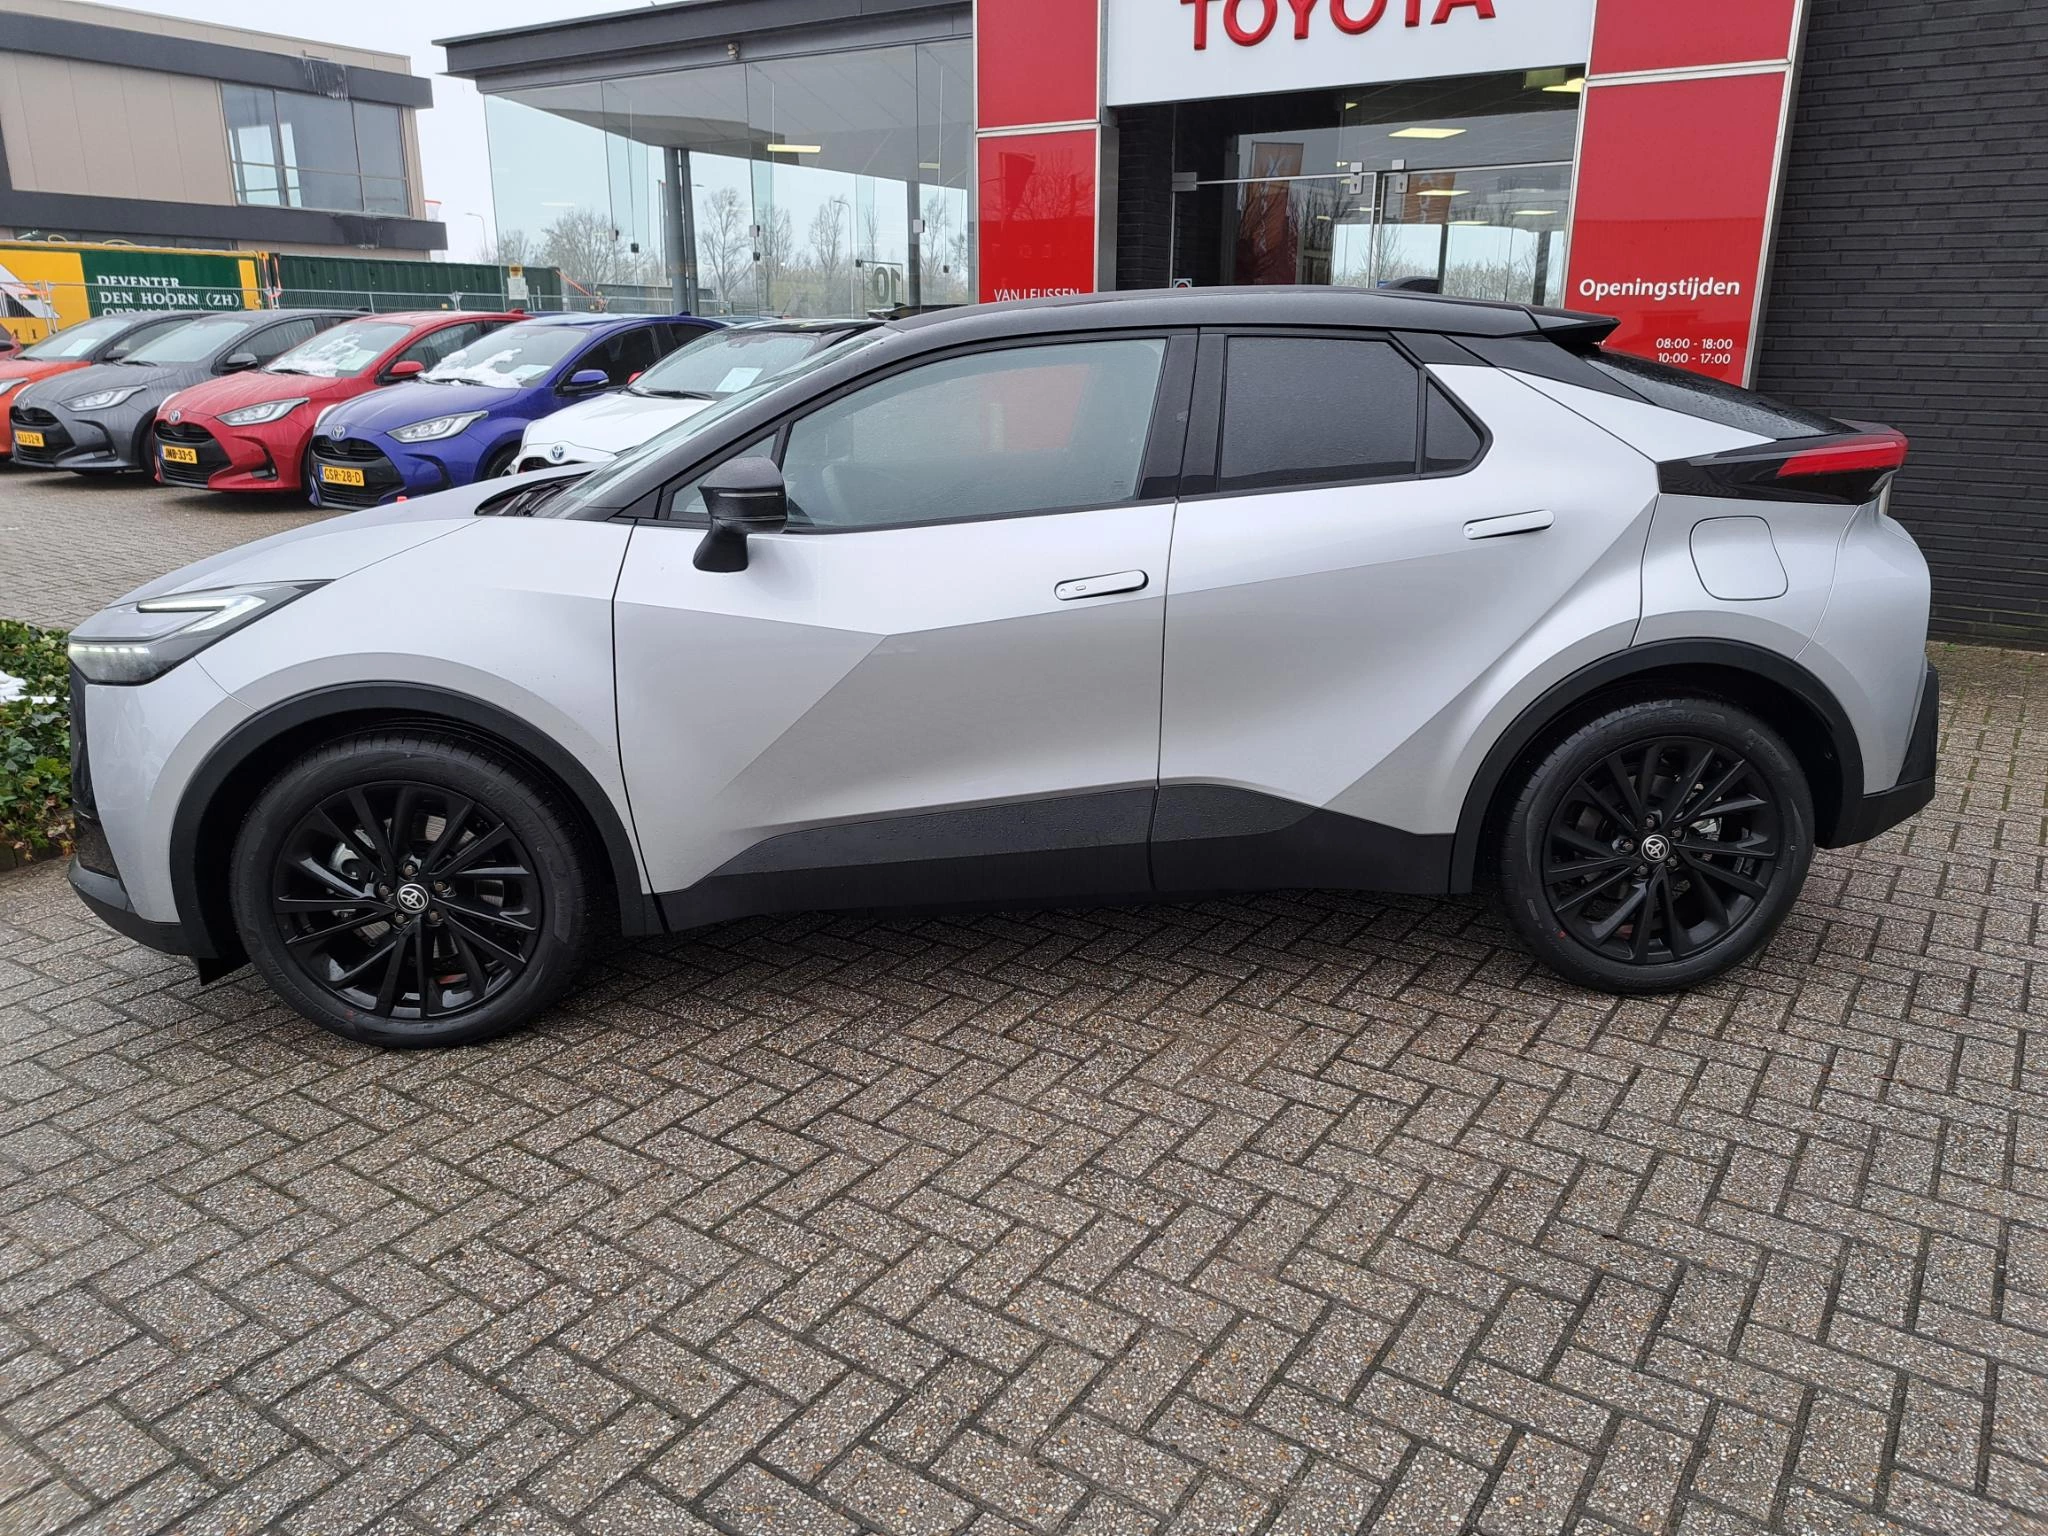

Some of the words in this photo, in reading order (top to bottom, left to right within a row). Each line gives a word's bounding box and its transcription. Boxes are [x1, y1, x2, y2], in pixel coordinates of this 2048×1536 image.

[96, 275, 180, 288] DEVENTER
[993, 288, 1020, 302] VAN
[1579, 277, 1740, 301] Openingstijden
[100, 291, 133, 304] DEN
[142, 292, 198, 305] HOORN
[206, 293, 240, 307] (ZH)
[1655, 338, 1690, 350] 08:00
[1702, 338, 1733, 350] 18:00
[1657, 352, 1689, 364] 10:00
[1700, 353, 1731, 364] 17:00
[324, 467, 361, 483] GSR-28-D
